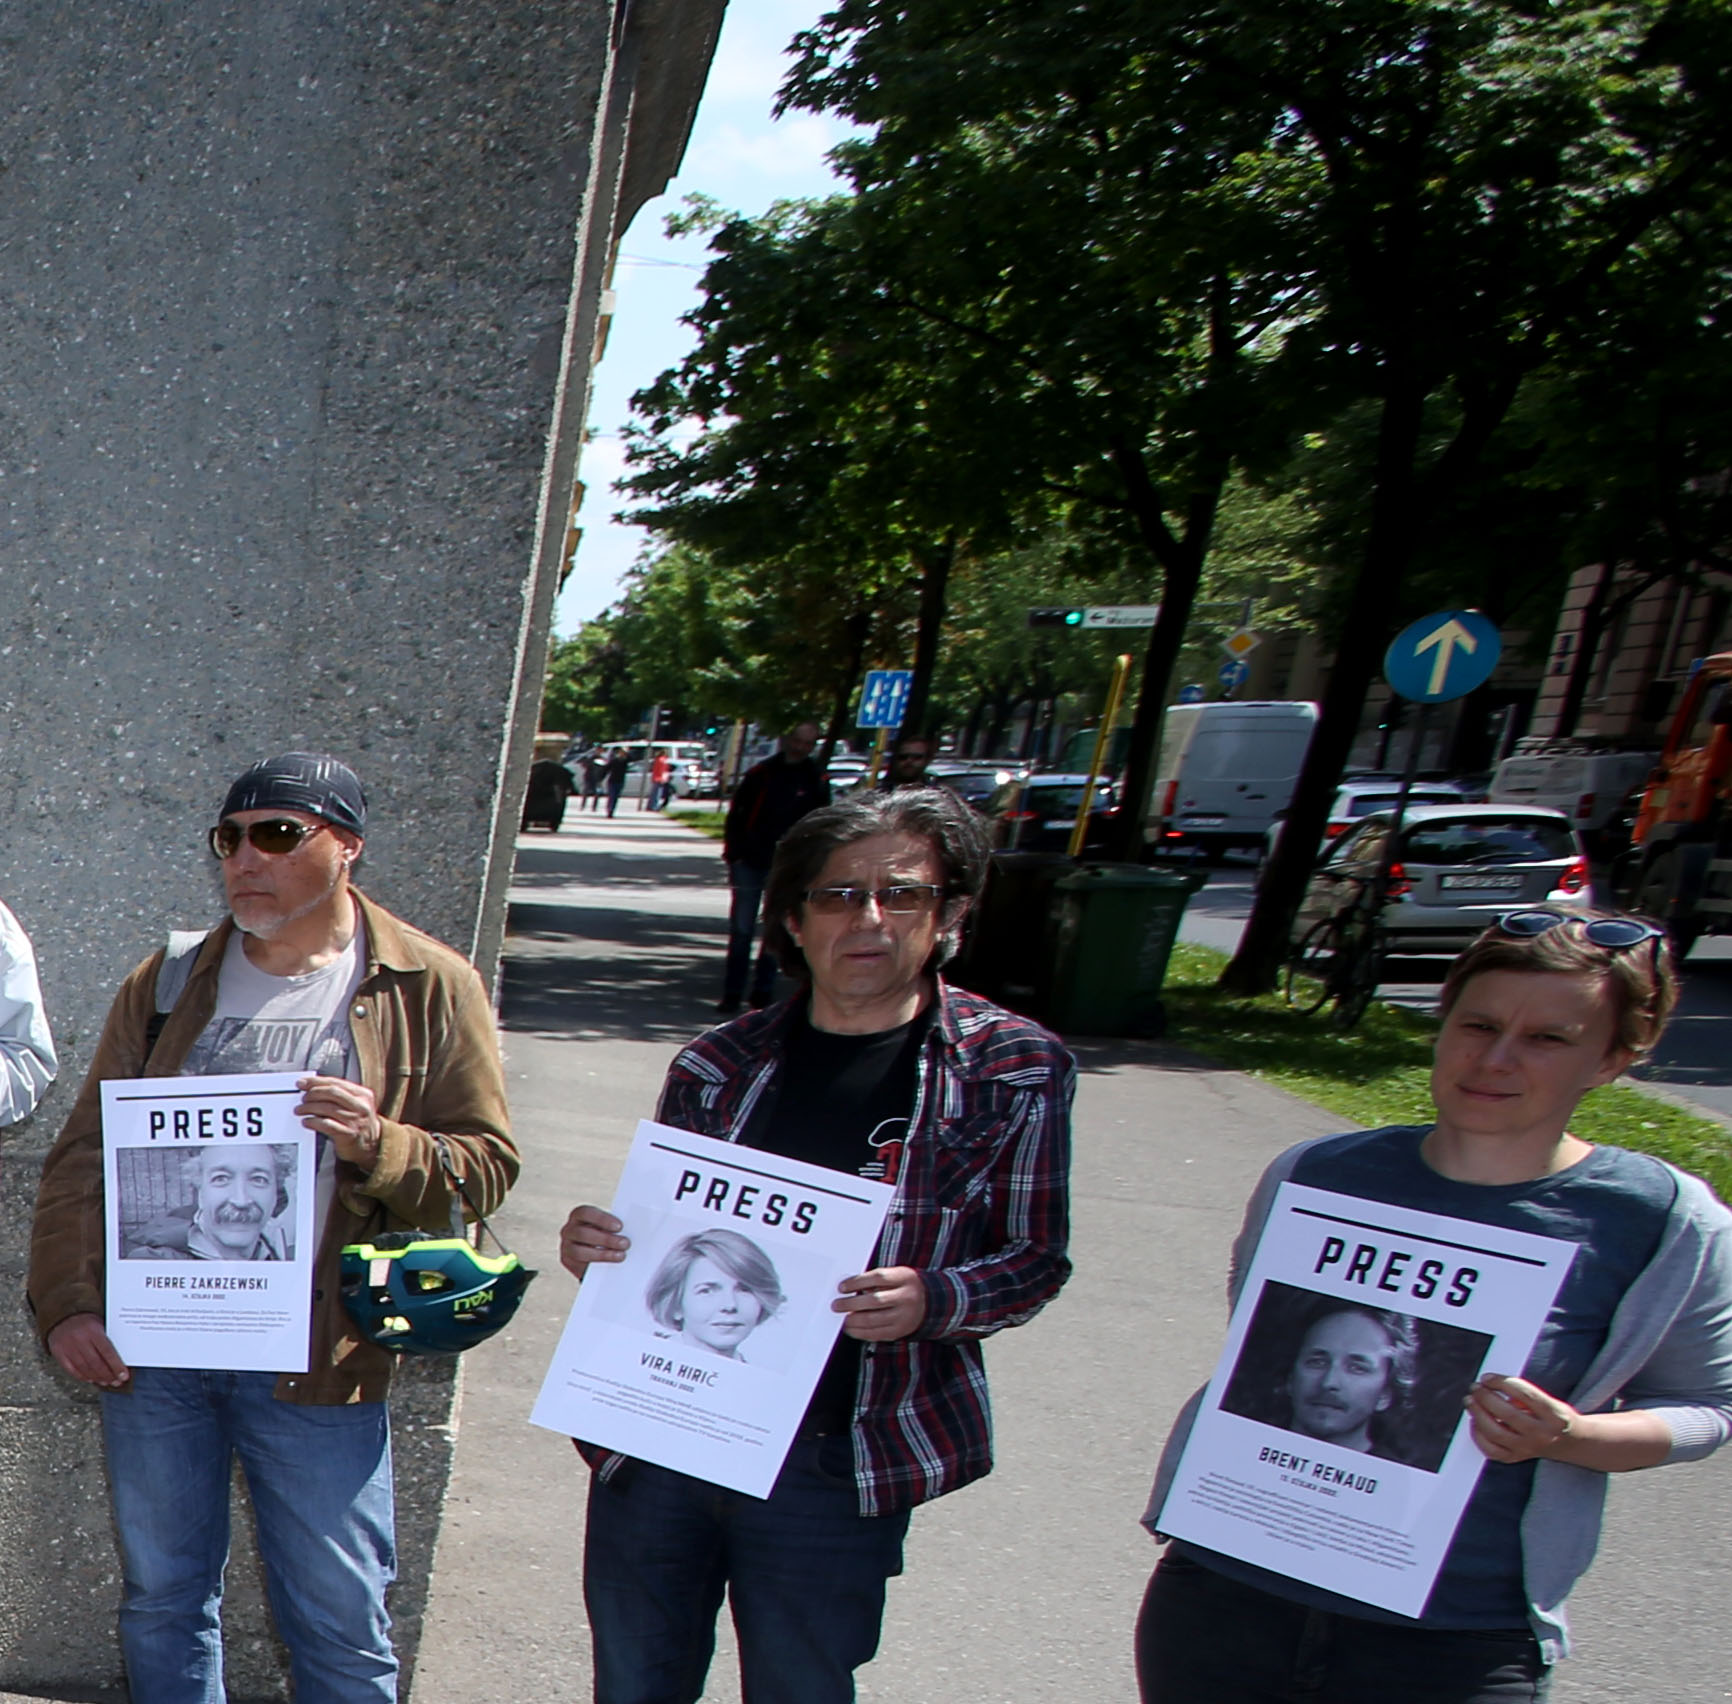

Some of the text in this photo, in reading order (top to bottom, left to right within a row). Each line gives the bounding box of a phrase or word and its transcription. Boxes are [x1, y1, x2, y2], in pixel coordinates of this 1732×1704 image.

[150, 1107, 264, 1140] PRESS
[675, 1170, 818, 1234] PRESS
[145, 1277, 268, 1290] PIERRE ZAKRZEWSKI
[1313, 1236, 1479, 1308] PRESS
[641, 1352, 673, 1374] VIRA
[1259, 1447, 1378, 1495] BRENT RENAUD
